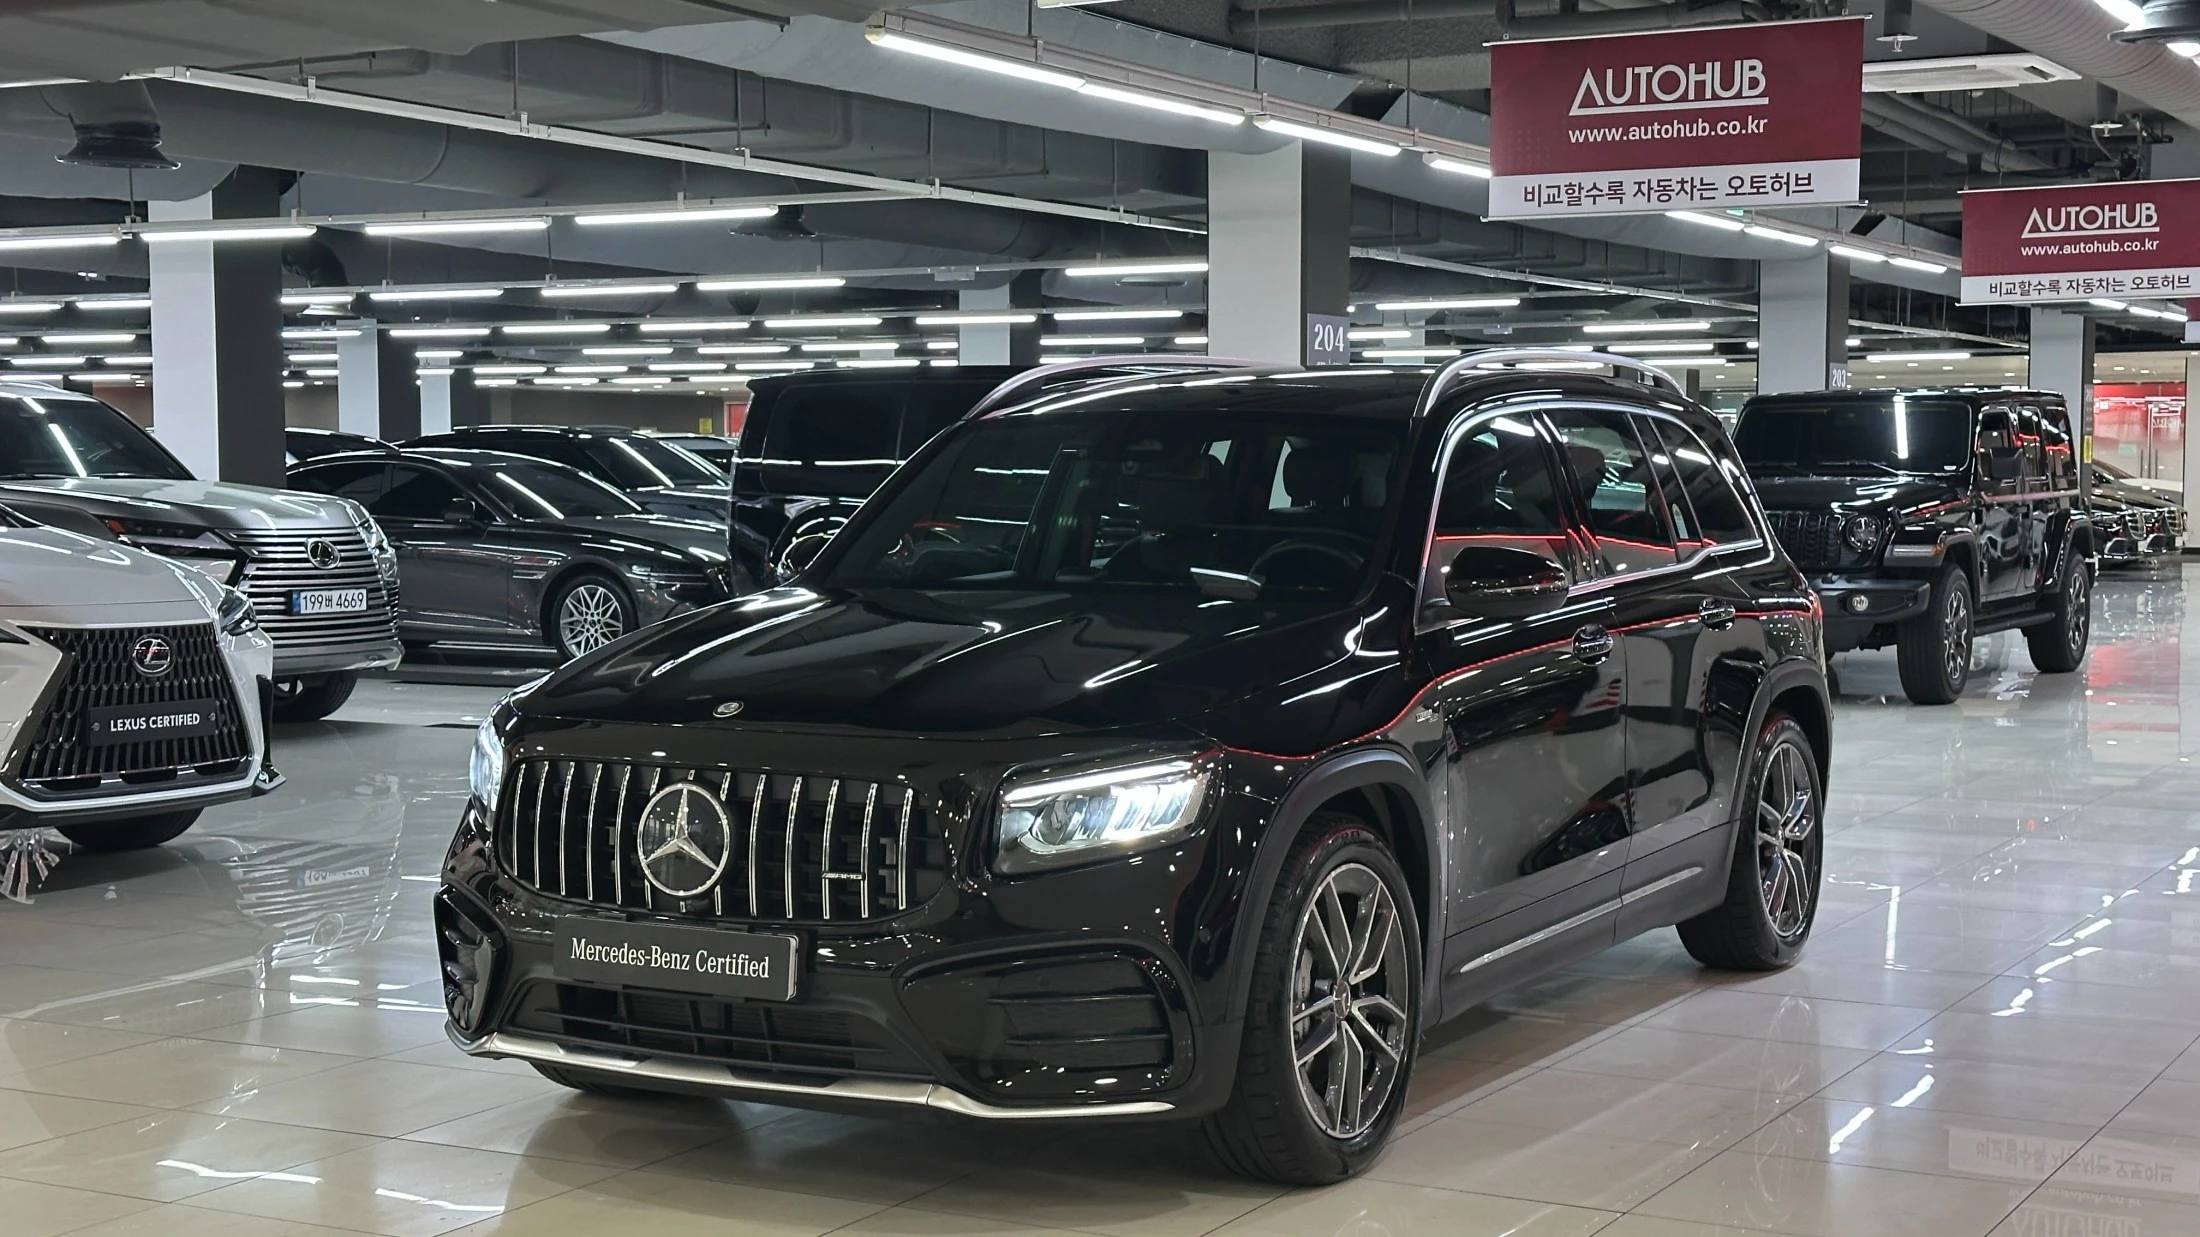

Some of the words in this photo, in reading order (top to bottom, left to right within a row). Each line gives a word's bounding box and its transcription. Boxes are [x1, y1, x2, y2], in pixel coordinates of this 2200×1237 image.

[1568, 58, 1769, 116] AUTOHUB
[1568, 116, 1768, 143] www.autohub.co.kr
[1523, 179, 1626, 208] 비교할수록
[1632, 176, 1719, 204] 자동차는
[1724, 172, 1815, 197] 오토허브
[2021, 202, 2160, 239] AUTOHUB
[2021, 238, 2159, 257] www.autohub.co.kr
[1989, 279, 2062, 297] 비교할수록
[2066, 276, 2126, 294] 자동차는
[2130, 274, 2191, 291] 오토허브
[1314, 323, 1345, 352] 204
[1832, 368, 1846, 388] 203
[302, 594, 333, 610] 199버
[336, 592, 364, 608] 4669
[110, 717, 147, 732] LEXUS
[149, 713, 200, 728] CERTIFIED
[570, 937, 690, 971] Mercedes-Benz
[695, 949, 770, 979] Certified
